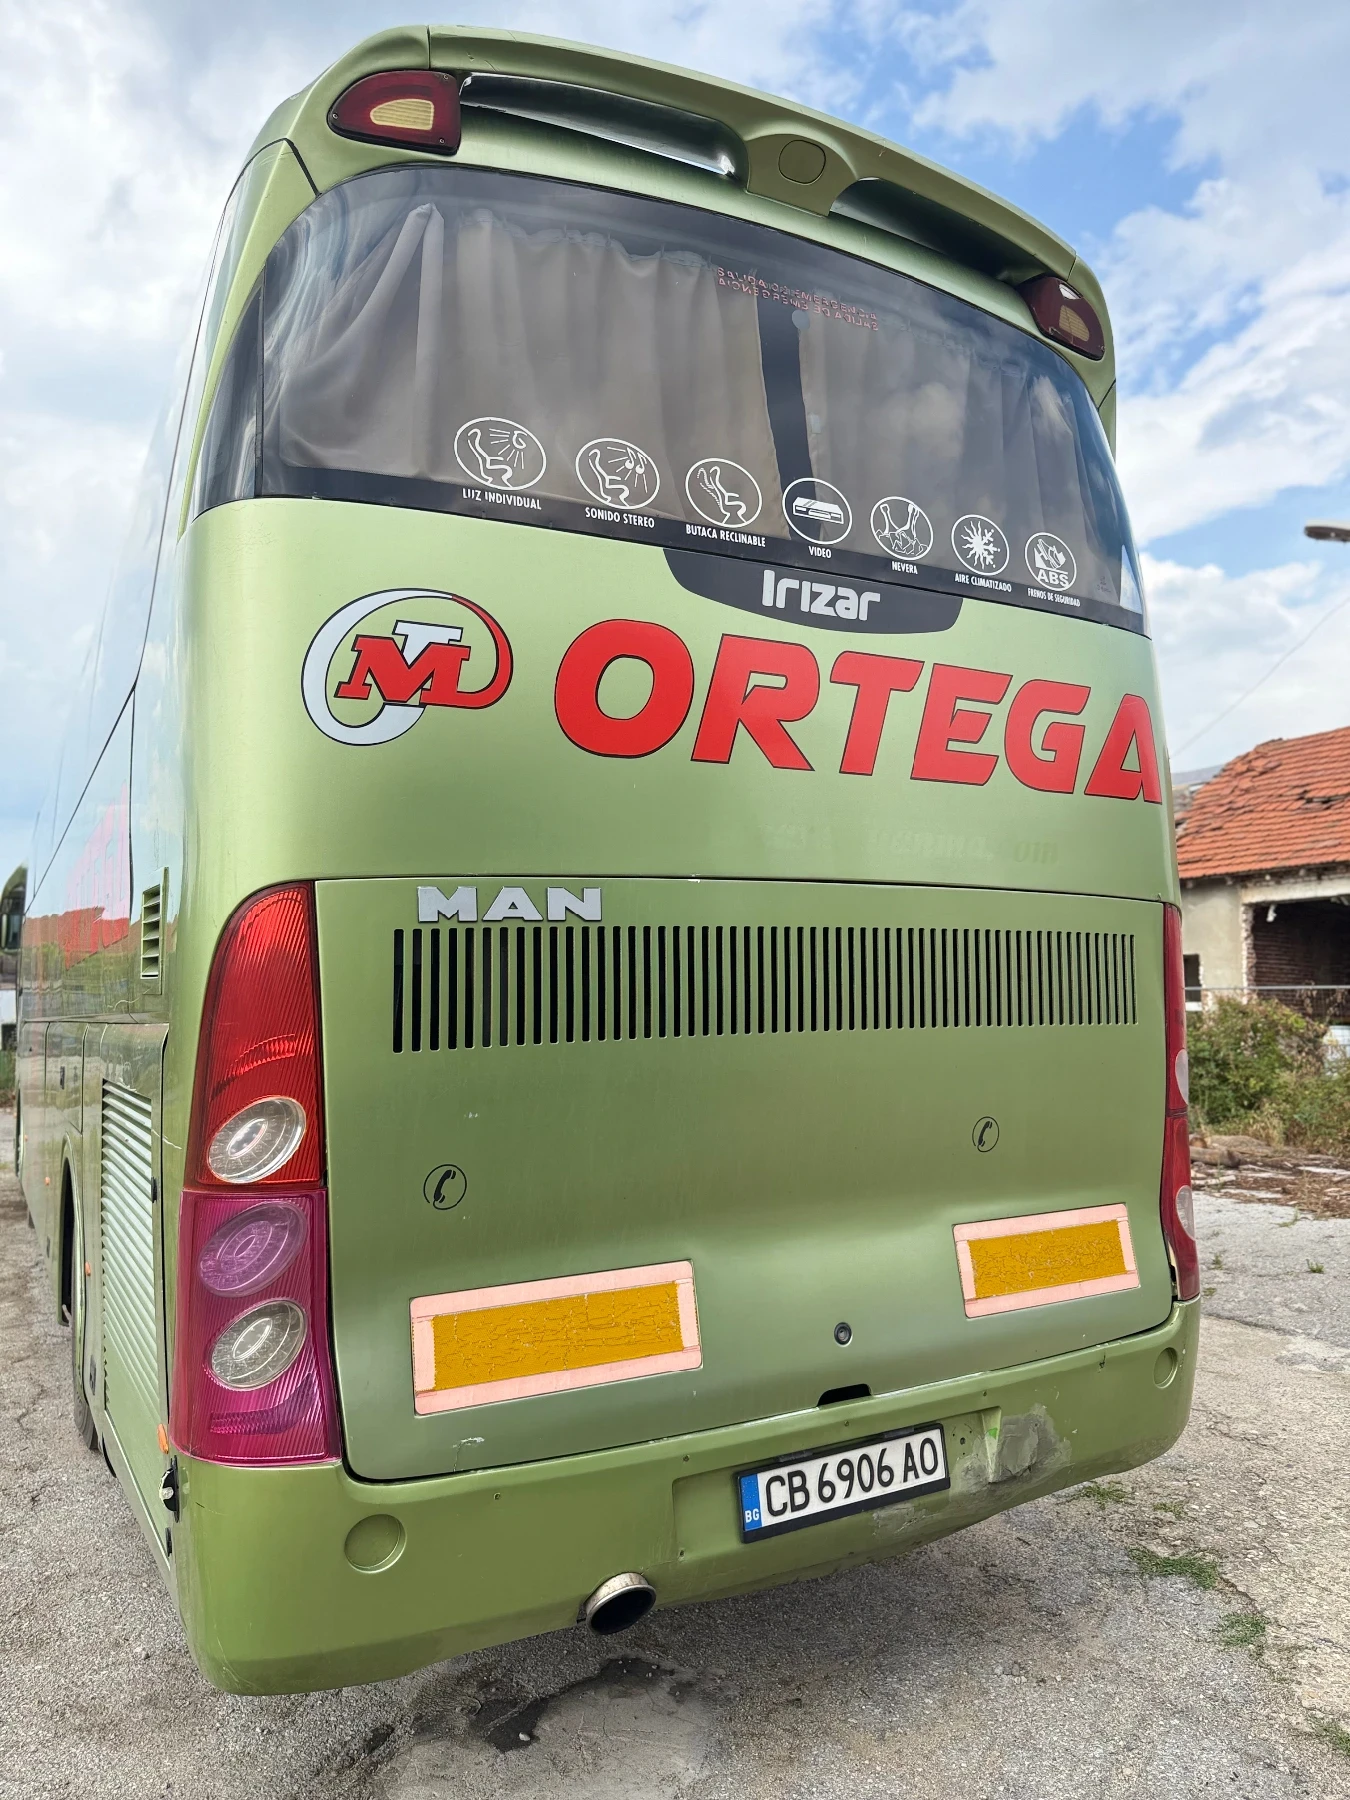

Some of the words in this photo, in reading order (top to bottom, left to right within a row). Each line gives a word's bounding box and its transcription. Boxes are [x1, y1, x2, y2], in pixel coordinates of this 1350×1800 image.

[462, 488, 482, 502] LUZ
[484, 491, 542, 510] INDIVIDUAL
[585, 507, 620, 524] SONIDO
[623, 513, 655, 528] STEREO
[686, 524, 718, 539] BUTACA
[720, 529, 766, 547] RECLINABLE
[809, 545, 832, 559] VIDEO
[892, 560, 918, 575] NEVERA
[955, 573, 970, 585] AIRE
[971, 576, 1012, 592] CLIMATIZADO
[1037, 569, 1070, 588] ABS
[762, 569, 881, 622] Irizar
[1027, 588, 1046, 599] FRENOS
[1047, 592, 1054, 601] DE
[1054, 593, 1081, 607] SEGURIDAD
[555, 619, 1162, 804] ORTEGA
[417, 886, 603, 923] MAN
[765, 1470, 810, 1517] CB
[817, 1448, 894, 1503] 6906
[744, 1508, 760, 1523] BG
